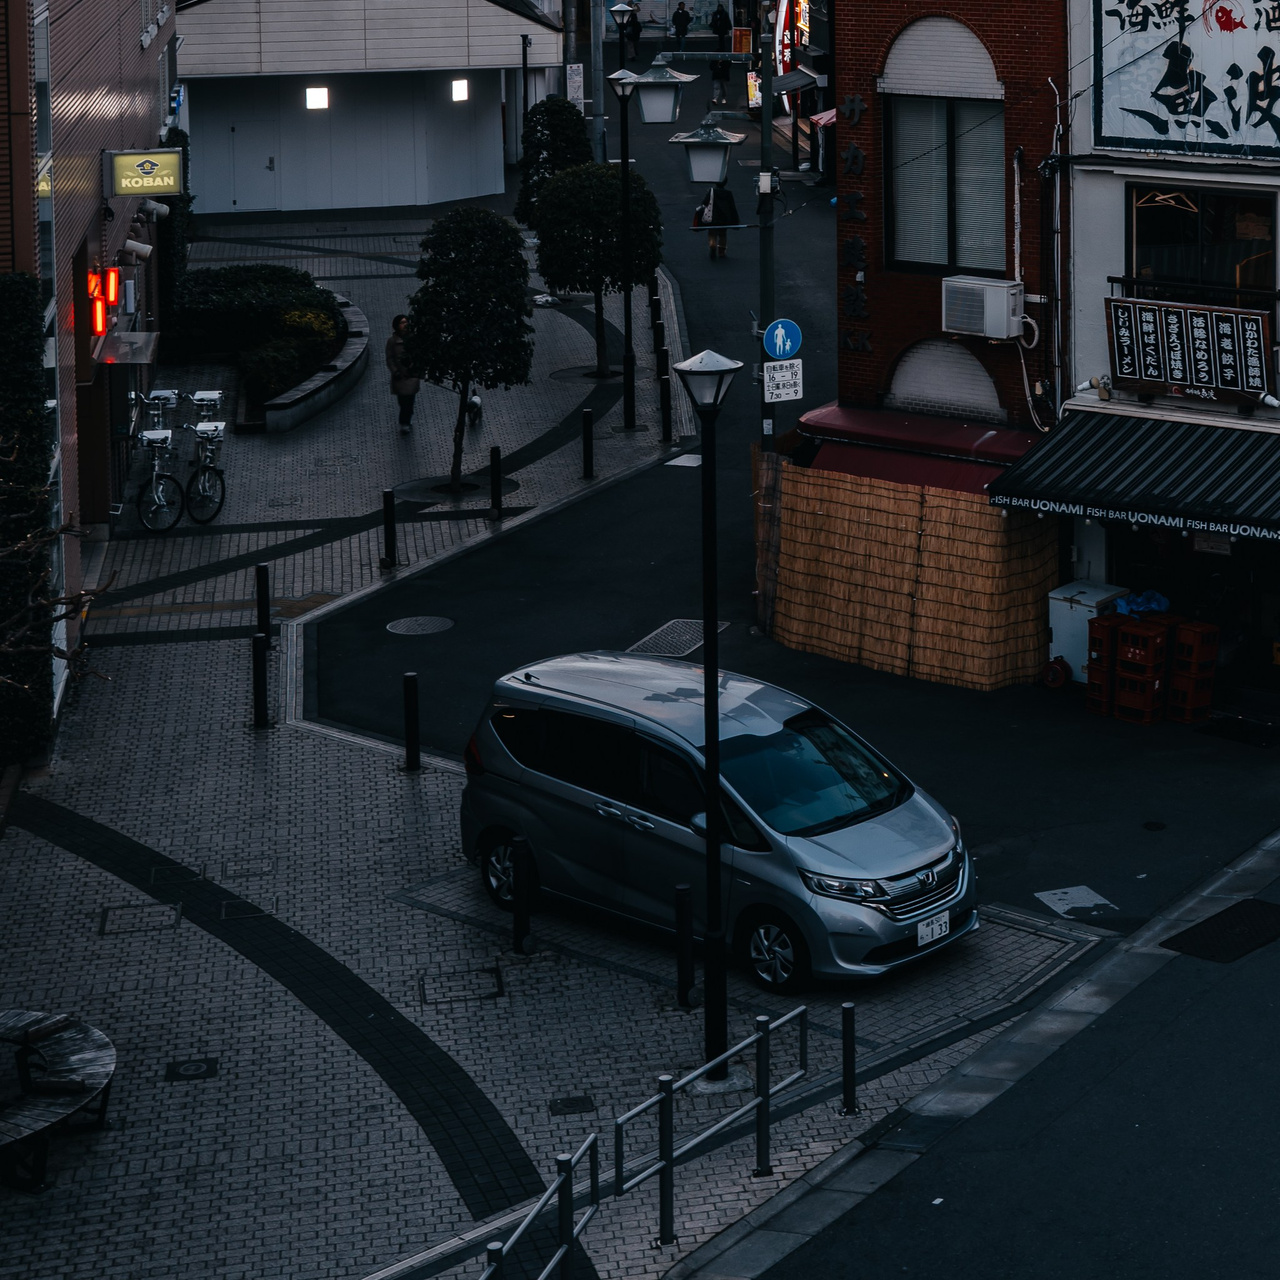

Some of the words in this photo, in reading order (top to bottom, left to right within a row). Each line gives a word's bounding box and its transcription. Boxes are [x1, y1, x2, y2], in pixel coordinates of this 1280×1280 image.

[121, 177, 174, 188] KOBAN
[1118, 309, 1133, 373] しじみラーメン
[1141, 311, 1158, 376] 海鮮ばくだん
[1218, 322, 1235, 380] 海老餃子
[1244, 321, 1262, 387] いかわた漁師焼
[791, 371, 798, 379] 19
[793, 389, 799, 397] 9
[1011, 498, 1028, 507] BAR
[1030, 499, 1083, 515] UONAMI
[1087, 507, 1106, 518] FISH
[1107, 510, 1126, 520] BAR
[1128, 511, 1183, 528] UONAMI
[1186, 519, 1206, 530] FISH
[1209, 522, 1228, 533] BAR
